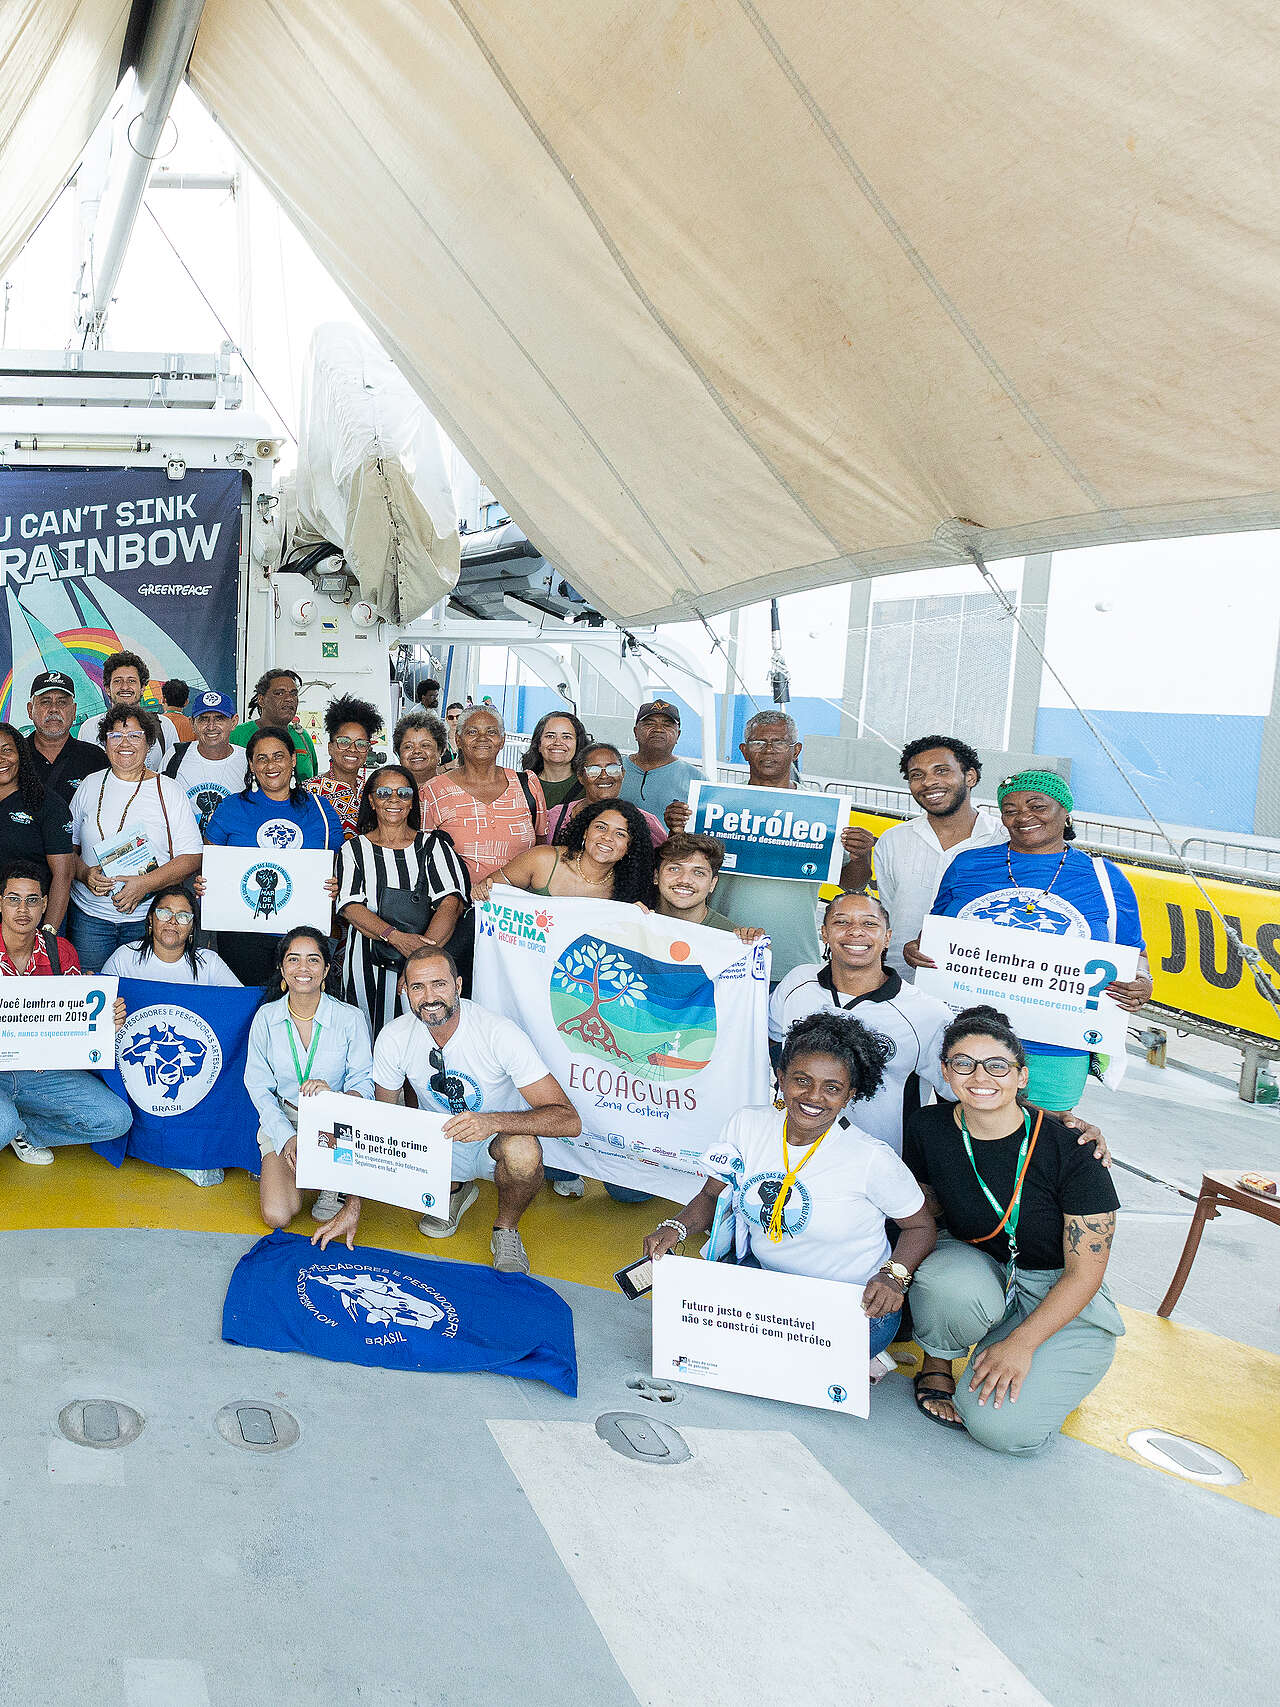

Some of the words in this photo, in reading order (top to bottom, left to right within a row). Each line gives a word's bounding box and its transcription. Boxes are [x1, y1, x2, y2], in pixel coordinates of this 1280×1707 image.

[20, 504, 108, 539] CAN'T
[116, 493, 198, 527] SINK
[137, 584, 212, 596] GREENPEACE
[703, 803, 828, 842] Petróleo
[716, 831, 746, 841] mentira
[748, 834, 757, 842] do
[759, 835, 824, 850] desenvolvimento
[498, 932, 517, 945] RECIFE
[528, 942, 546, 953] COP30
[499, 919, 546, 943] CLIMA
[949, 943, 981, 960] Você
[986, 950, 1035, 969] lembra
[1041, 961, 1049, 971] o
[1054, 963, 1081, 977] que
[946, 962, 1017, 983] aconteceu
[1022, 976, 1044, 988] em
[1049, 978, 1085, 995] 2019
[23, 998, 56, 1008] lembra
[68, 999, 84, 1010] que
[976, 986, 1006, 999] nunca
[48, 1014, 62, 1022] em
[65, 1012, 87, 1022] 2019
[125, 1008, 167, 1030] PESCADORES
[175, 1009, 215, 1044] PESCADORAS
[569, 1063, 697, 1111] ECOÁGUAS
[595, 1096, 622, 1111] Zona
[627, 1102, 670, 1120] Costeira
[355, 1130, 360, 1138] 6
[364, 1133, 384, 1143] anos
[401, 1141, 428, 1152] crime
[355, 1140, 365, 1150] do
[369, 1147, 406, 1158] petróleo
[403, 1275, 459, 1324] PESCADORAS
[682, 1299, 714, 1313] Futuro
[717, 1304, 742, 1318] justo
[746, 1311, 752, 1319] e
[755, 1312, 815, 1331] sustentável
[365, 1331, 407, 1346] BRASIL
[682, 1314, 699, 1324] não
[703, 1318, 713, 1326] se
[716, 1320, 759, 1334] constrói
[762, 1326, 783, 1338] com
[787, 1332, 832, 1348] petróleo
